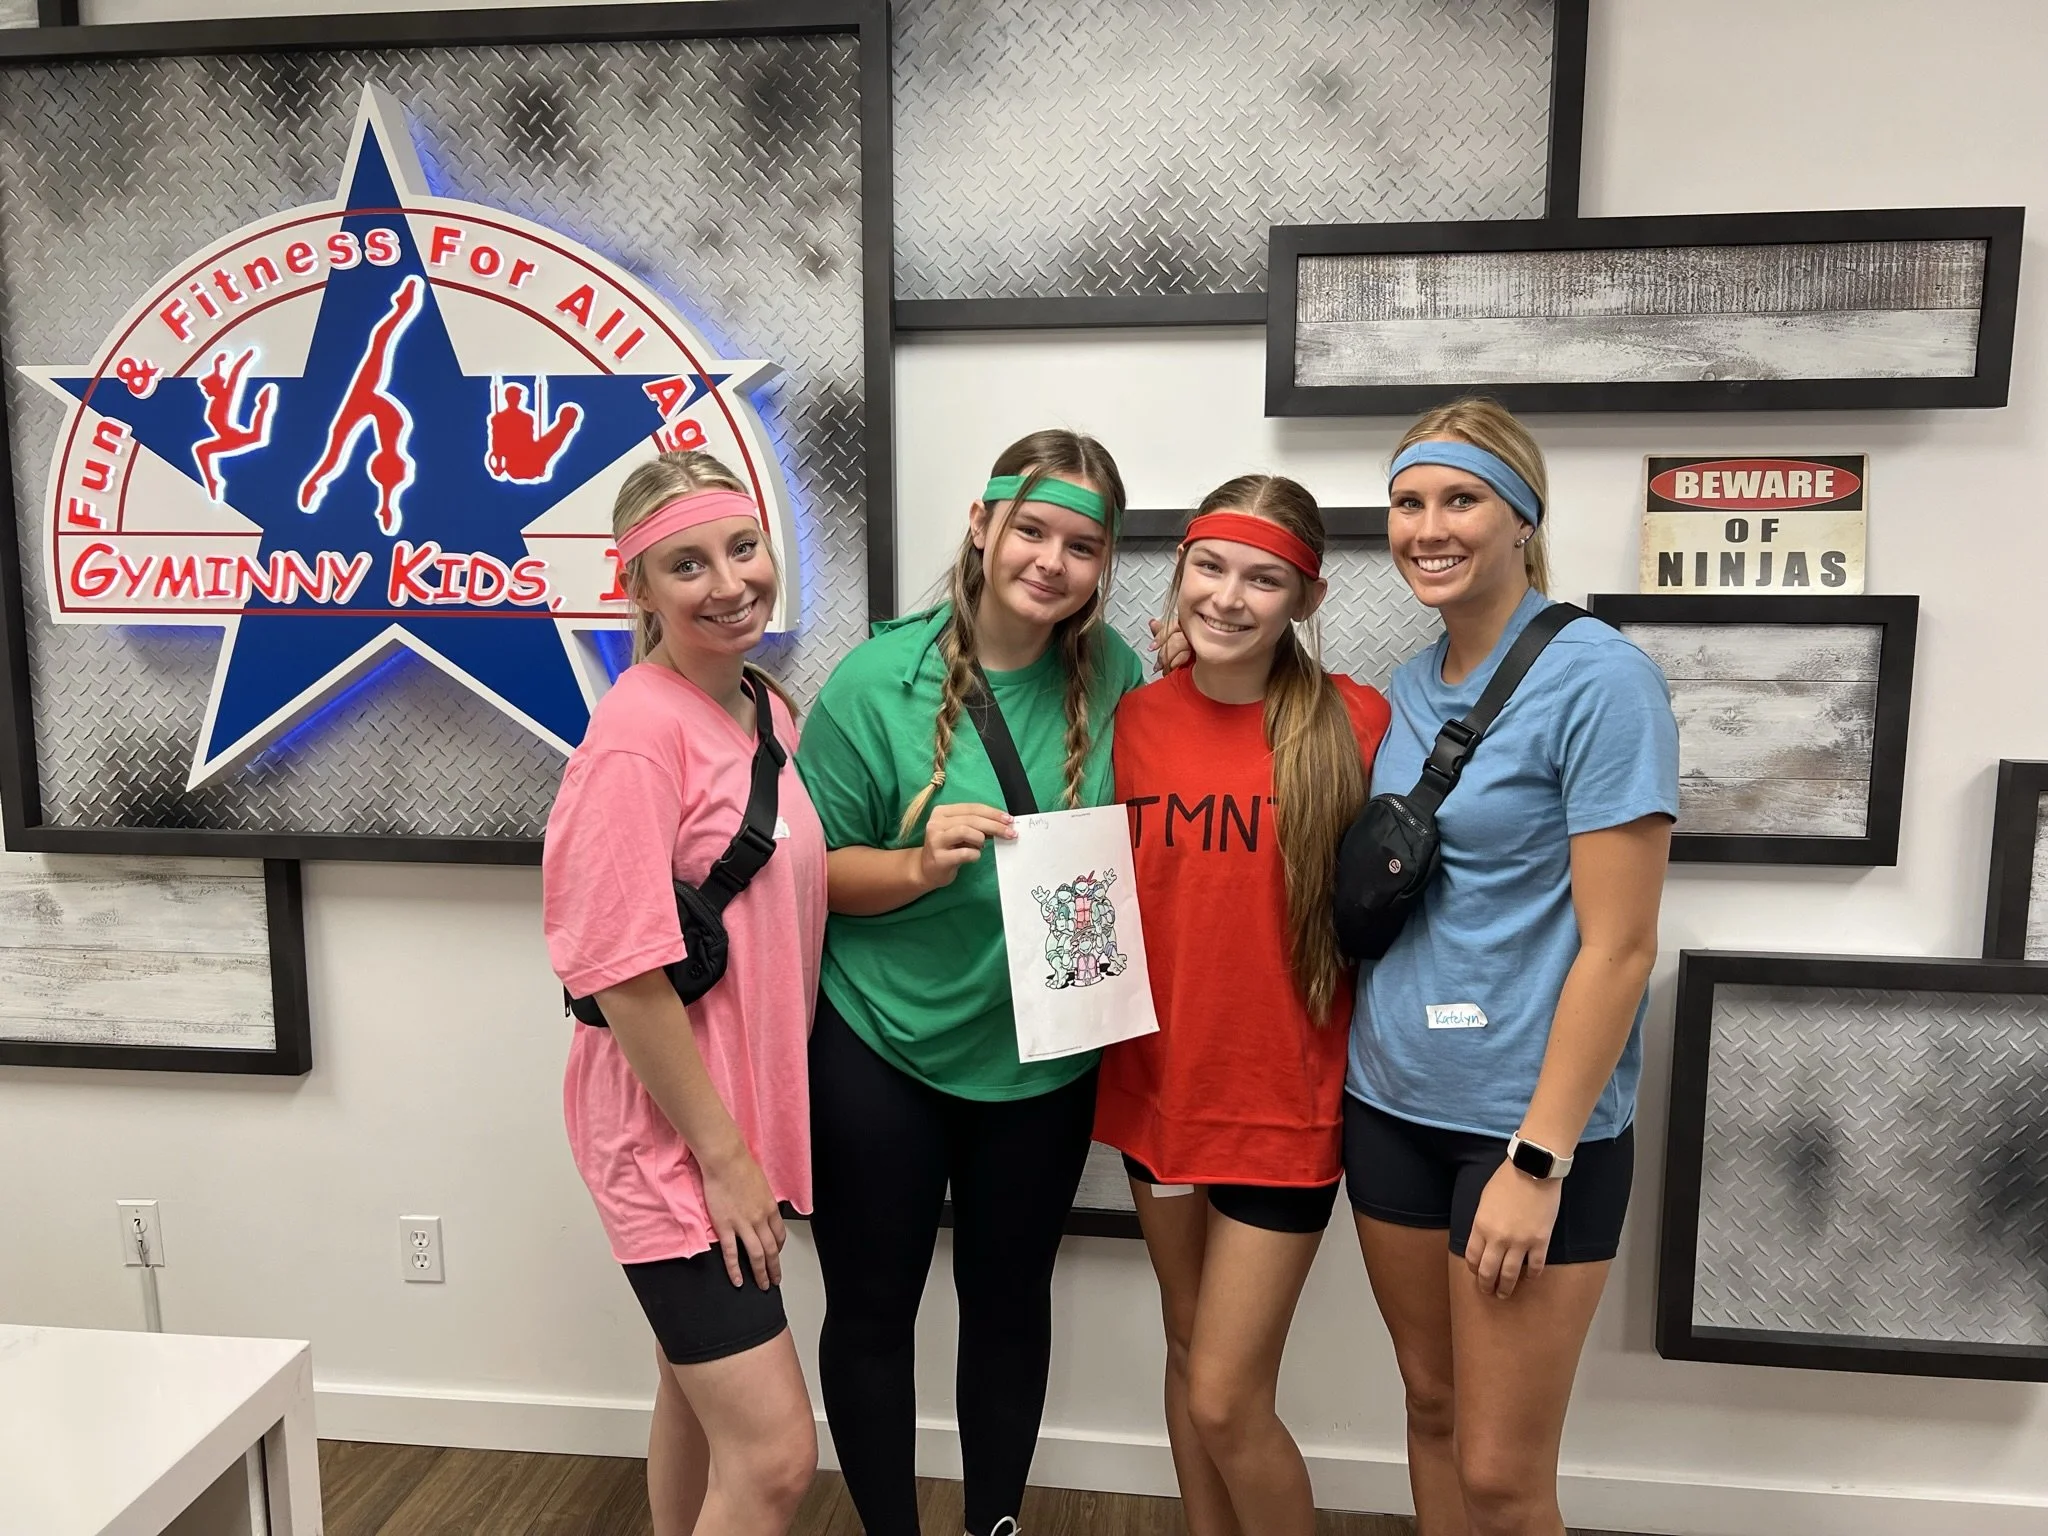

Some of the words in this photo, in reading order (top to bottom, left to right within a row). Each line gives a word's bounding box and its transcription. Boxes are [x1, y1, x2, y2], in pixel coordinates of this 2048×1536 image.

[67, 417, 133, 530] Fun
[116, 357, 164, 399] &
[160, 228, 401, 343] Fitness
[430, 226, 539, 289] For
[555, 284, 649, 361] All
[642, 374, 711, 452] Ag
[1675, 470, 1834, 499] BEWARE
[1725, 518, 1779, 543] OF
[71, 543, 372, 604] GYMINNY
[1658, 551, 1847, 588] NINJAS
[1126, 793, 1279, 853] TMN
